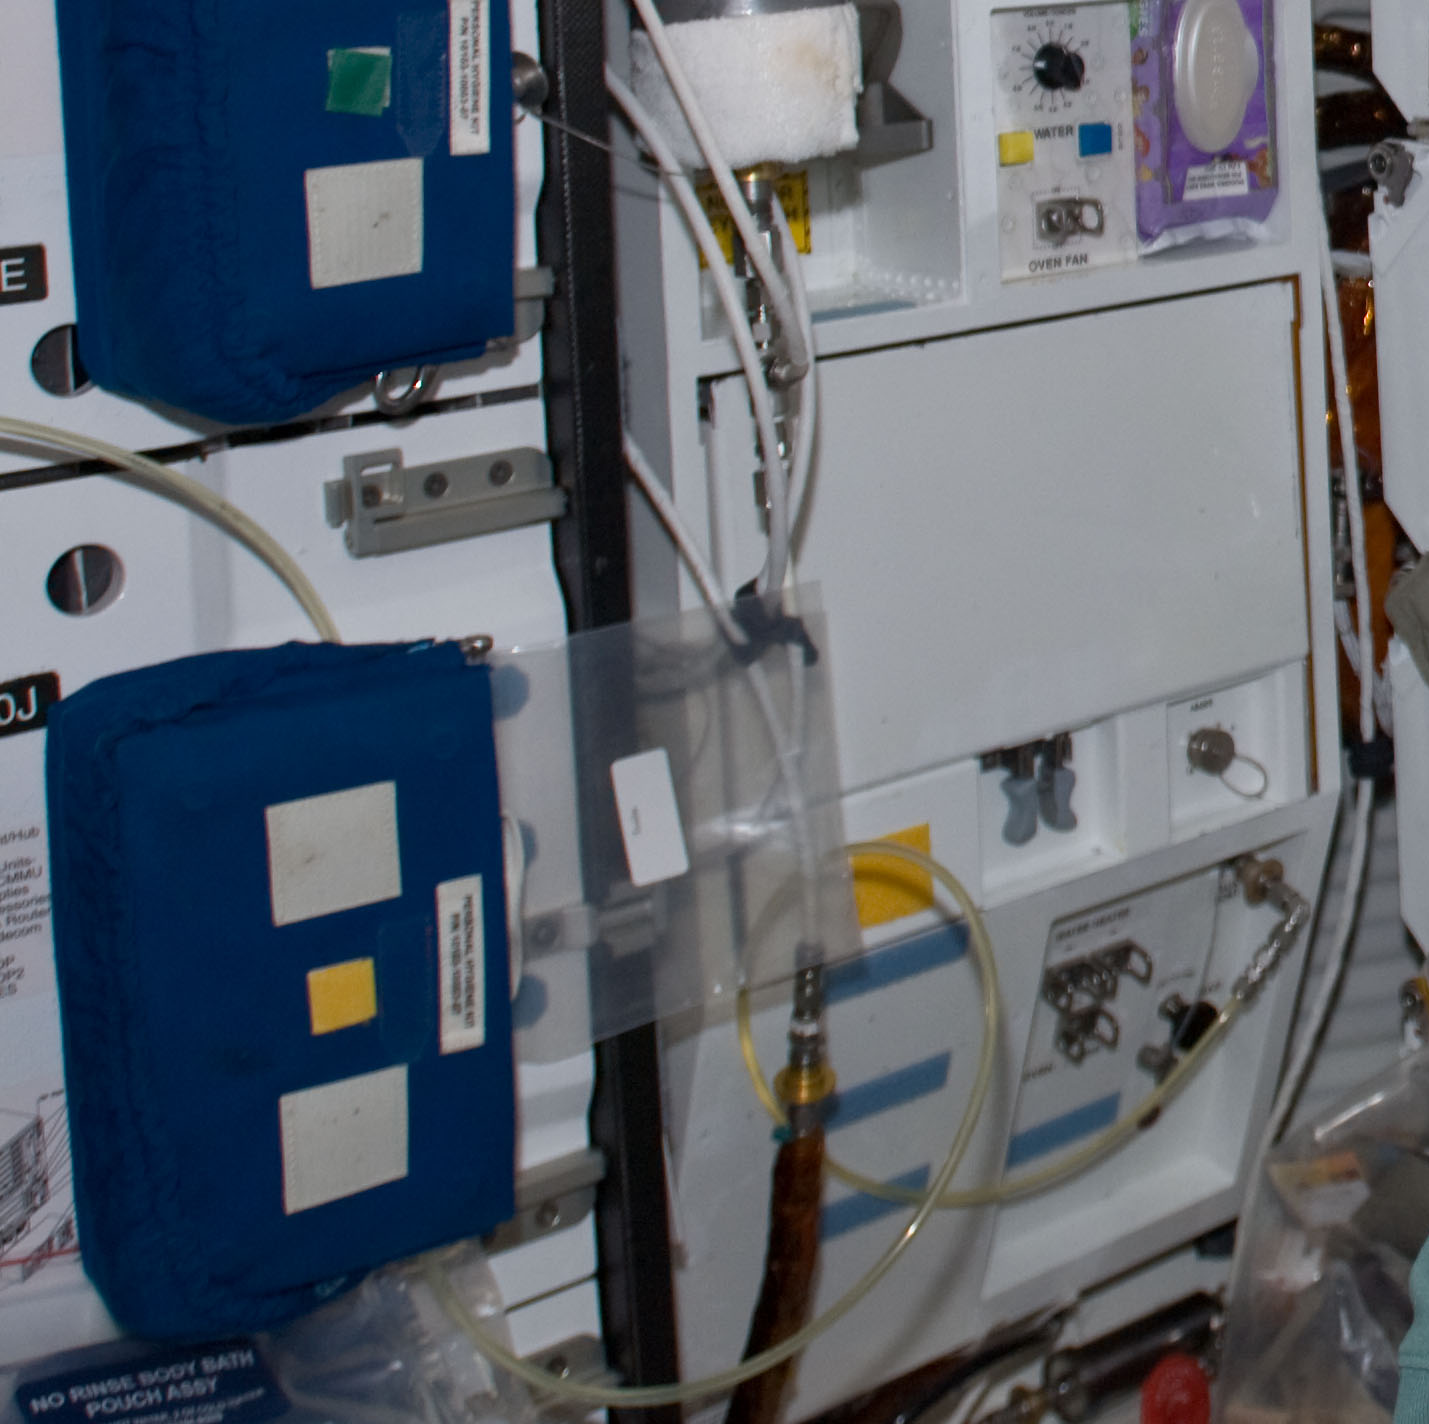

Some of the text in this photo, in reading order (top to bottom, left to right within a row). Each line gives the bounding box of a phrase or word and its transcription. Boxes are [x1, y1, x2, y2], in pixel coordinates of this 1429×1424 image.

[470, 0, 480, 134] PERSONAL HYGIENE KIT
[1034, 126, 1073, 139] WATER
[1028, 253, 1088, 272] OVEN FAN
[28, 1390, 67, 1414] NO
[67, 1373, 137, 1403] RINSE
[135, 1359, 198, 1388] BODY
[199, 1346, 256, 1375] BATH
[83, 1386, 164, 1419] POUCH
[164, 1374, 219, 1402] ASSY
